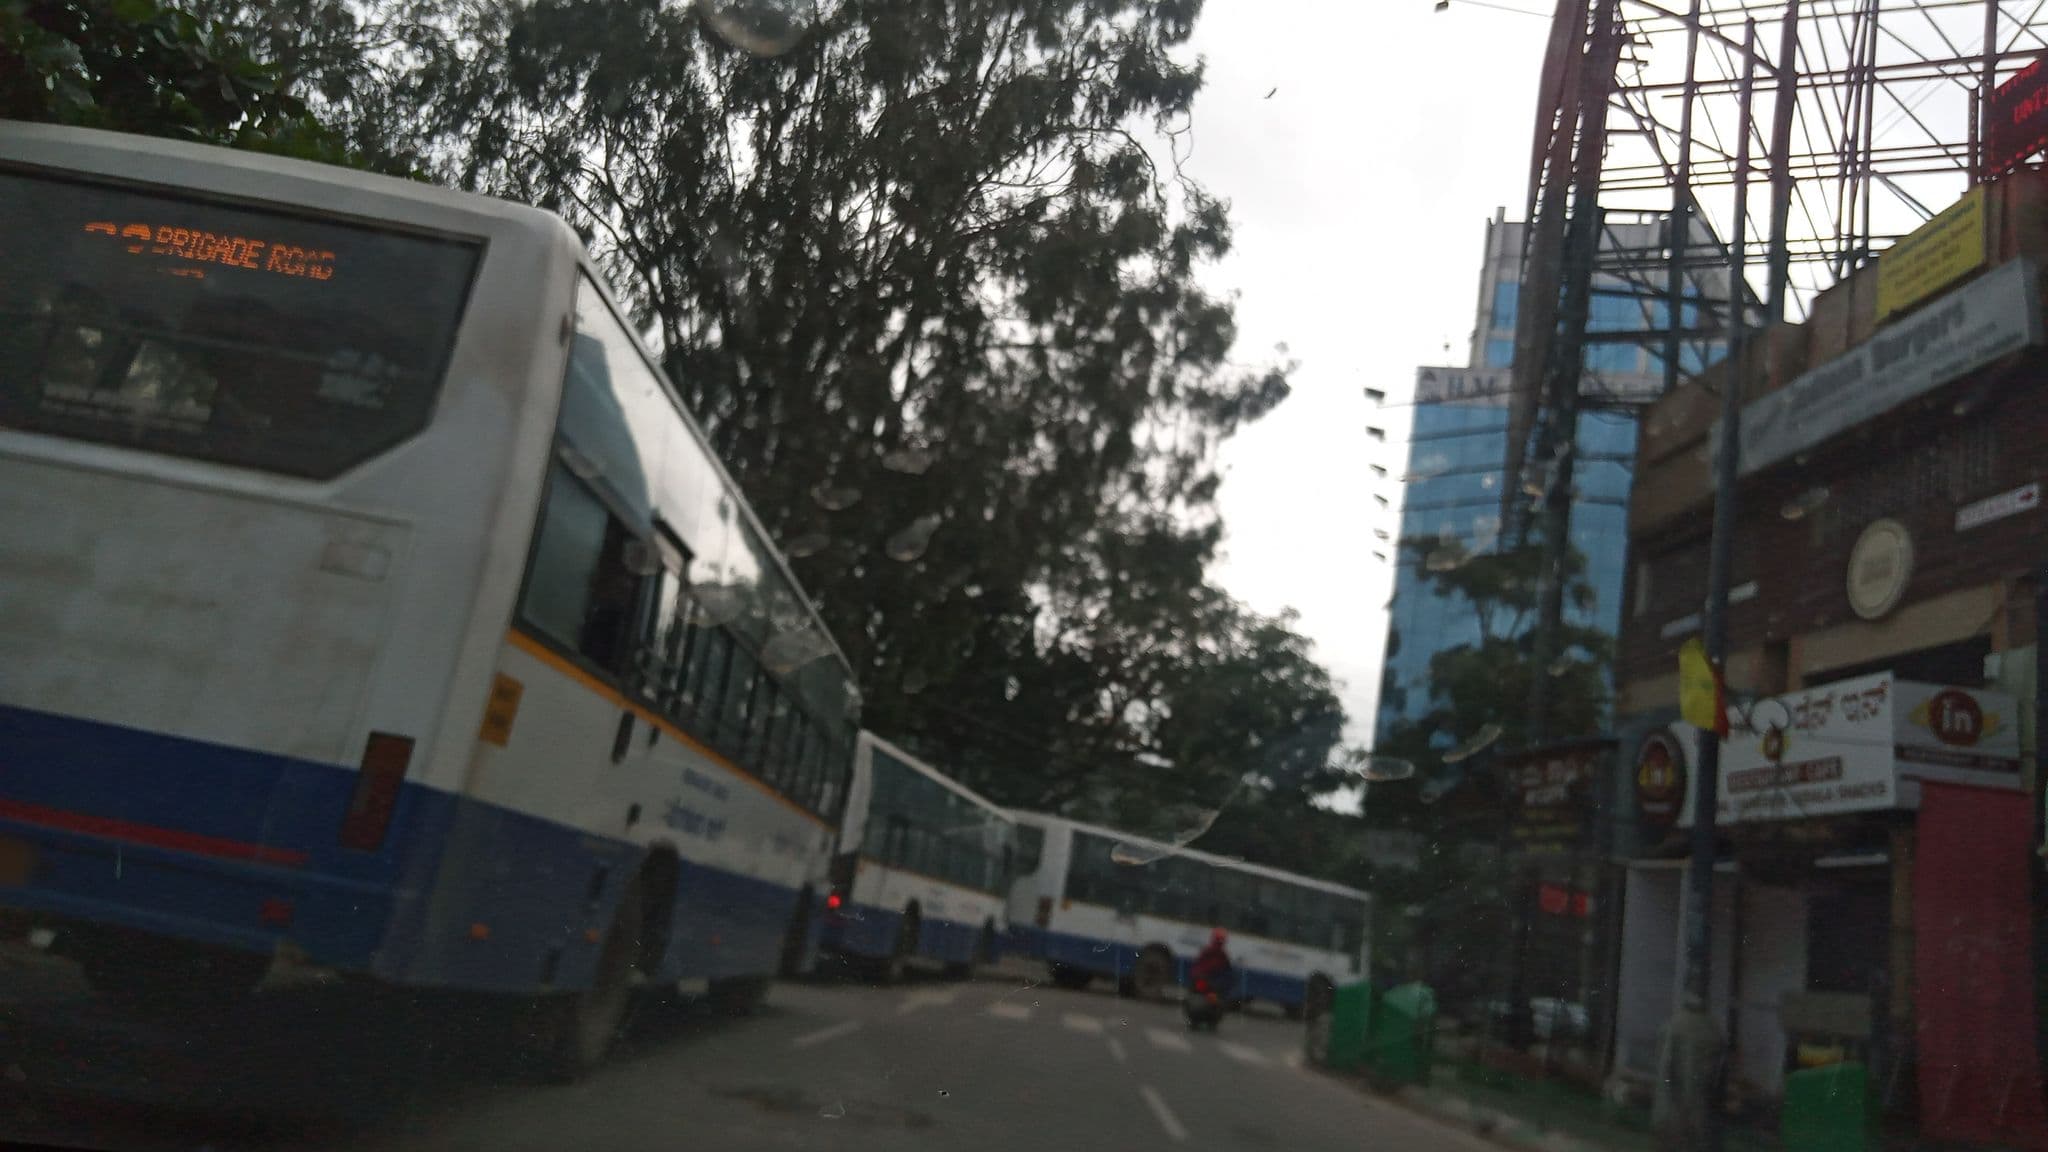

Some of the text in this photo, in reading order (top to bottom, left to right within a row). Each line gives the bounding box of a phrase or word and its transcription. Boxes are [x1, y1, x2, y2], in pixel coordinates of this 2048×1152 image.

[152, 226, 264, 268] BRIGADE
[266, 243, 335, 280] ROAD
[1942, 698, 1974, 733] in
